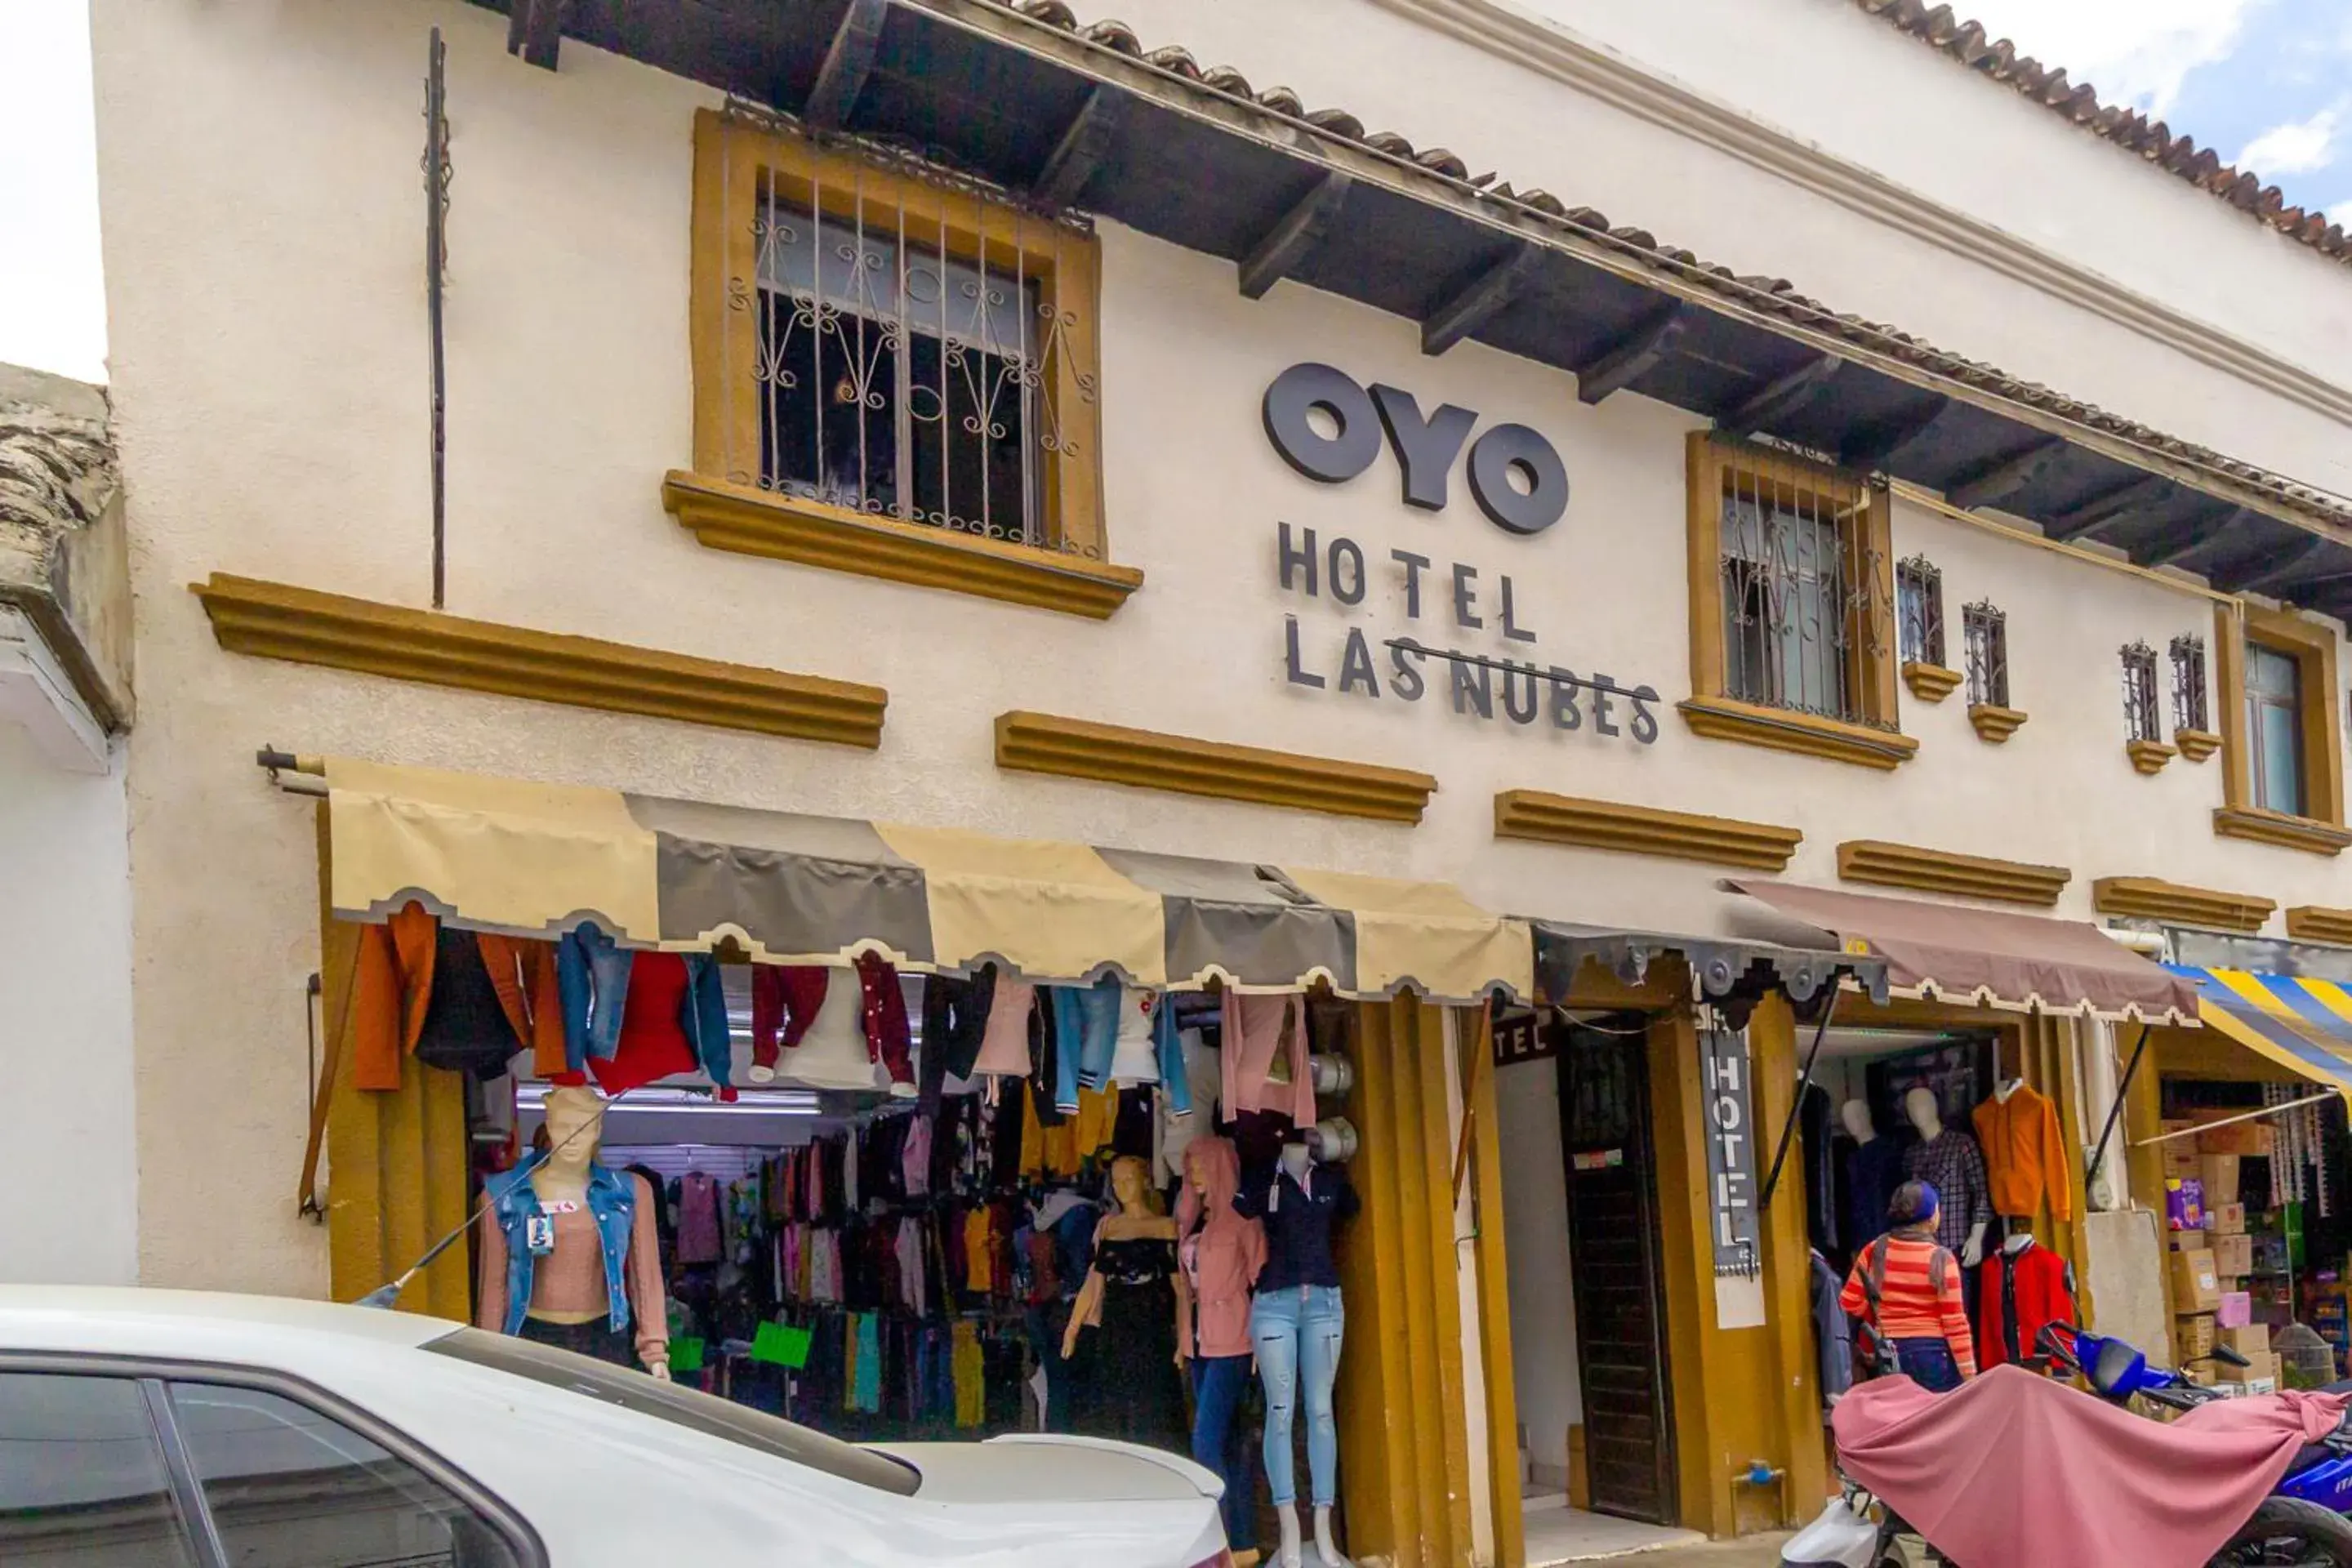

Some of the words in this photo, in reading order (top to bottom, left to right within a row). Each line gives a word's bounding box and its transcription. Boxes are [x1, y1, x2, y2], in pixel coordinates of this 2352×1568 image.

[1262, 362, 1570, 536] OYO
[1278, 521, 1537, 644] HOTEL
[1285, 613, 1426, 702] LAS
[1448, 648, 1660, 745] NUBES
[1708, 1056, 1750, 1247] HOTEL
